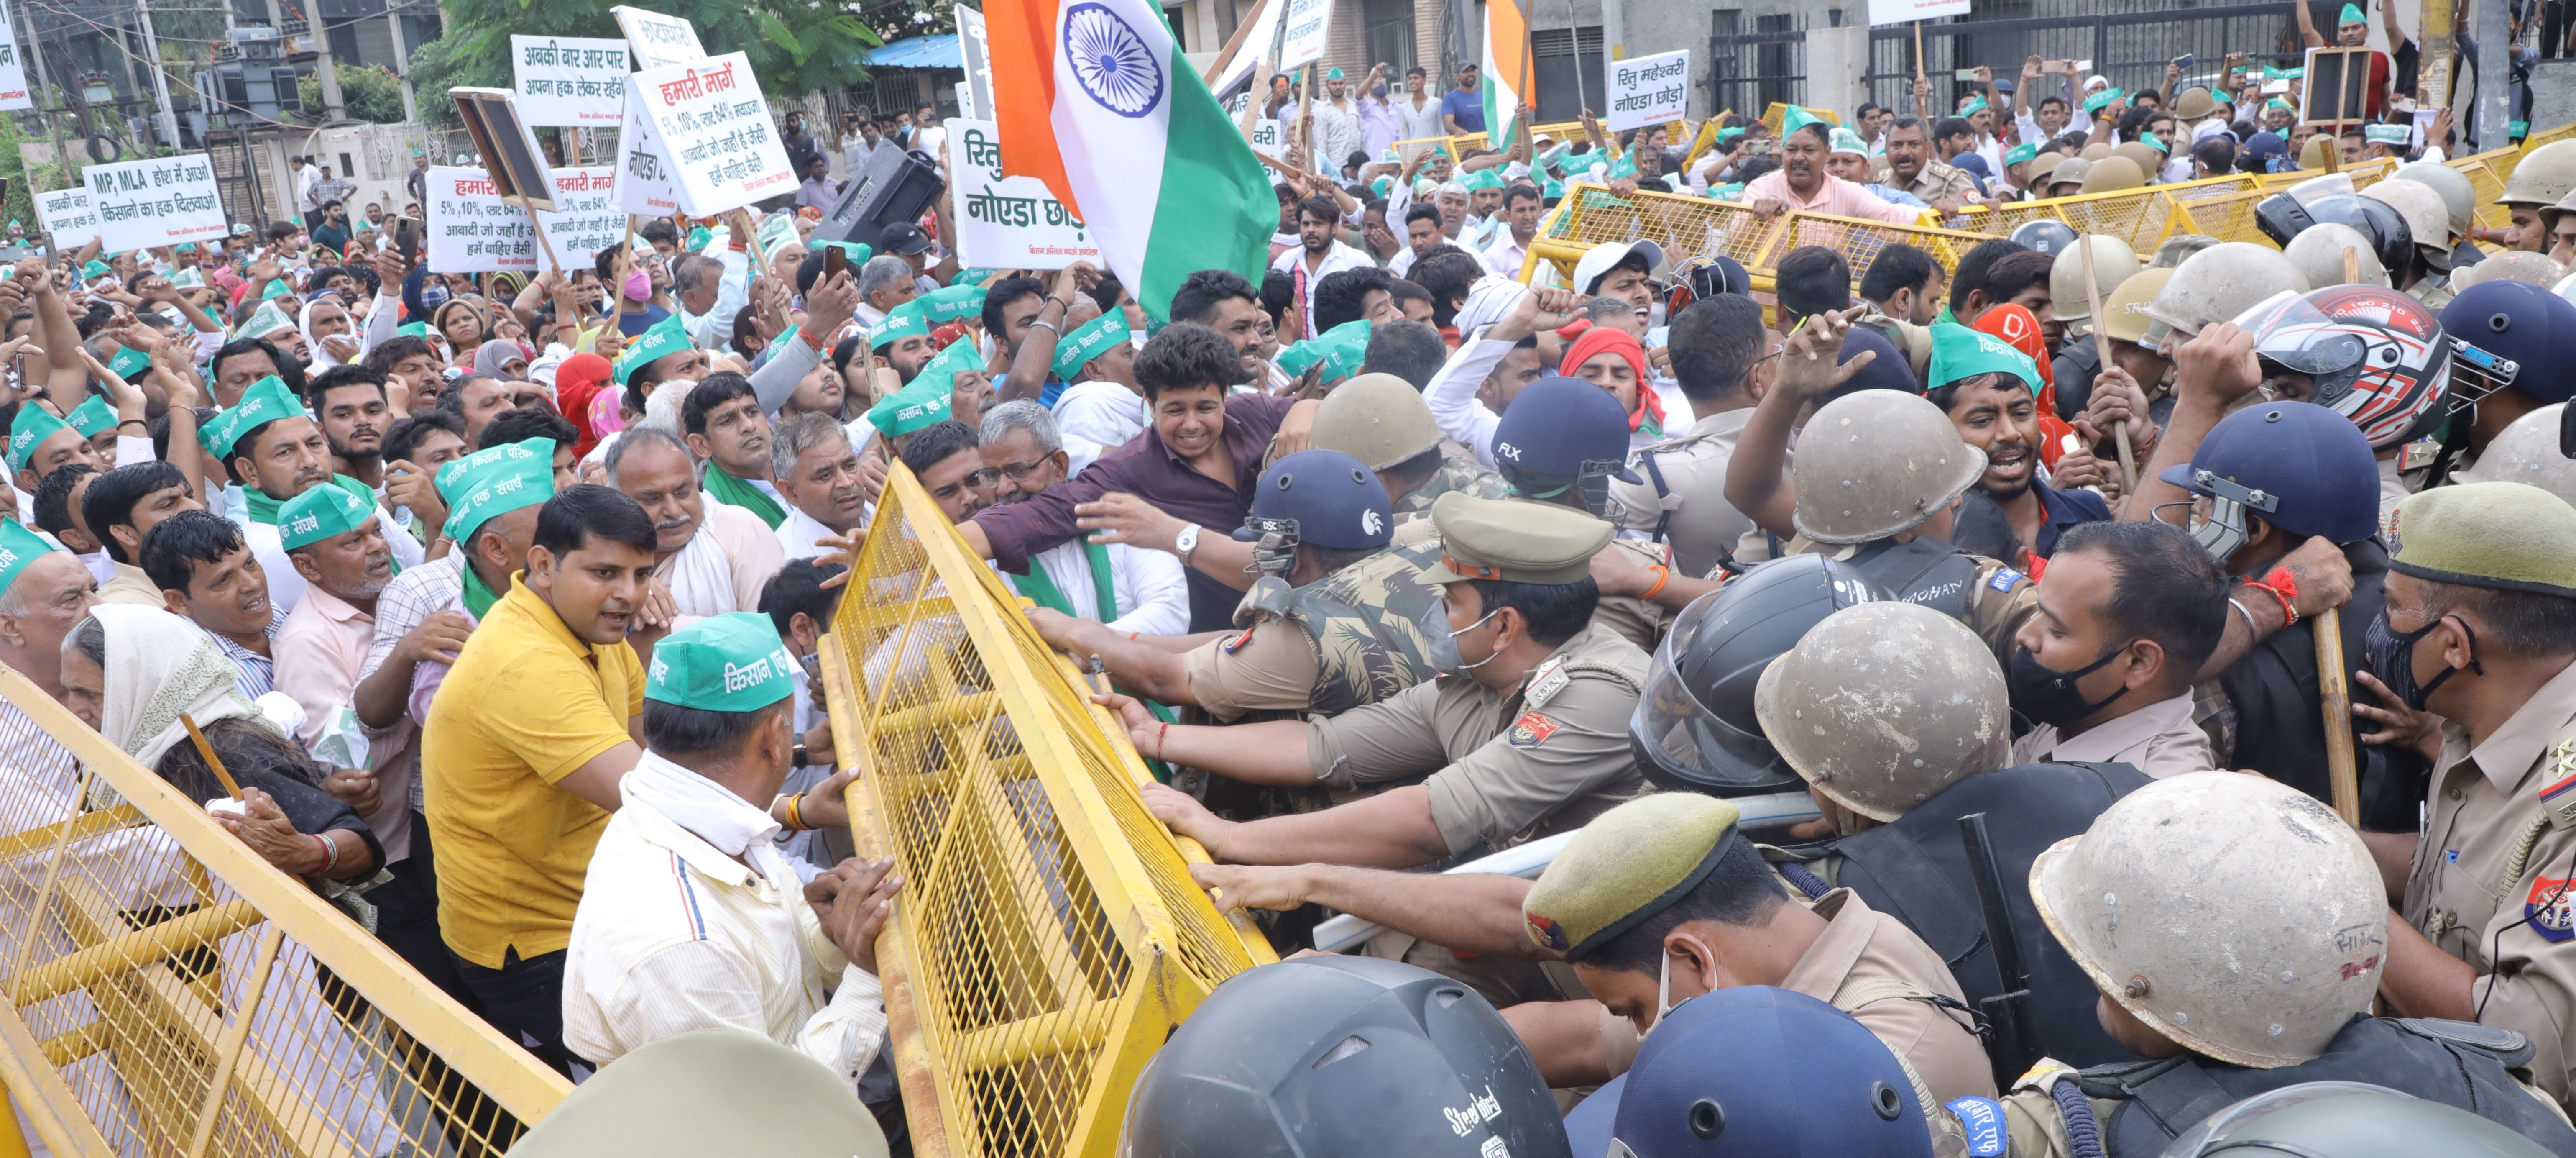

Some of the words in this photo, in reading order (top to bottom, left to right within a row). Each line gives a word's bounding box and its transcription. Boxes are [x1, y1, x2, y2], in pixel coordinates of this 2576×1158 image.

[525, 39, 558, 66] अबकी
[561, 49, 580, 67] बार
[583, 50, 603, 68] आर
[606, 51, 623, 69] पार
[1618, 69, 1638, 90] रितु
[1641, 58, 1684, 81] महेश्वरी
[526, 80, 553, 95] अपना
[556, 81, 573, 97] हक
[576, 75, 601, 97] लेकर
[659, 68, 703, 106] हमारी
[1615, 93, 1653, 112] नोएडा
[1656, 83, 1684, 109] छोड़ो
[699, 111, 716, 127] प्लाट
[713, 101, 734, 123] 64%
[706, 136, 721, 156] जो
[738, 128, 748, 149] है
[746, 123, 767, 144] जैसी
[629, 142, 657, 181] नोएडा
[708, 164, 725, 187] हमें
[723, 159, 748, 179] चाहिए
[746, 152, 764, 172] वैसी
[93, 172, 118, 197] MP,
[118, 169, 148, 191] MLA
[153, 165, 173, 187] होश
[174, 164, 182, 182] में
[185, 160, 209, 182] आओ
[556, 171, 588, 193] हमारी
[47, 192, 72, 212] अबकी
[72, 195, 88, 208] बार
[100, 199, 138, 222] किसानो
[140, 203, 155, 217] का
[156, 200, 173, 217] हक
[174, 190, 217, 213] दिलवाओ
[441, 200, 455, 215] 5%
[486, 206, 502, 216] प्लाट
[593, 197, 607, 210] 64%
[966, 184, 1036, 227] नोएडा
[52, 219, 72, 231] अपना
[74, 215, 87, 228] हक
[481, 222, 493, 236] जो
[496, 222, 515, 237] जहाँ
[516, 222, 524, 237] है
[577, 218, 585, 231] जो
[604, 215, 609, 231] है
[611, 215, 626, 228] जैसी
[467, 241, 484, 256] हमें
[485, 241, 511, 256] चाहिए
[513, 240, 530, 256] वैसी
[567, 236, 579, 251] हमें
[580, 234, 600, 249] चाहिए
[602, 233, 615, 248] वैसी
[1029, 244, 1045, 255] किसान
[888, 316, 909, 330] परिषद
[2382, 302, 2406, 315] 210
[2411, 318, 2426, 341] 230
[644, 332, 666, 350] परिषद
[1079, 329, 1104, 349] किसान
[1978, 336, 2015, 359] किसान
[113, 355, 132, 371] परिषद
[238, 398, 262, 418] परिषद
[895, 404, 922, 423] किसान
[925, 400, 940, 414] एक
[15, 429, 36, 449] परिषद
[1498, 442, 1522, 462] FLX
[446, 462, 468, 488] भारतीय
[472, 450, 501, 469] किसान
[472, 488, 491, 507] एक
[495, 474, 524, 495] संघर्ष
[291, 510, 320, 535] संघर्ष
[1263, 521, 1278, 531] DSC
[724, 658, 773, 694] किसान
